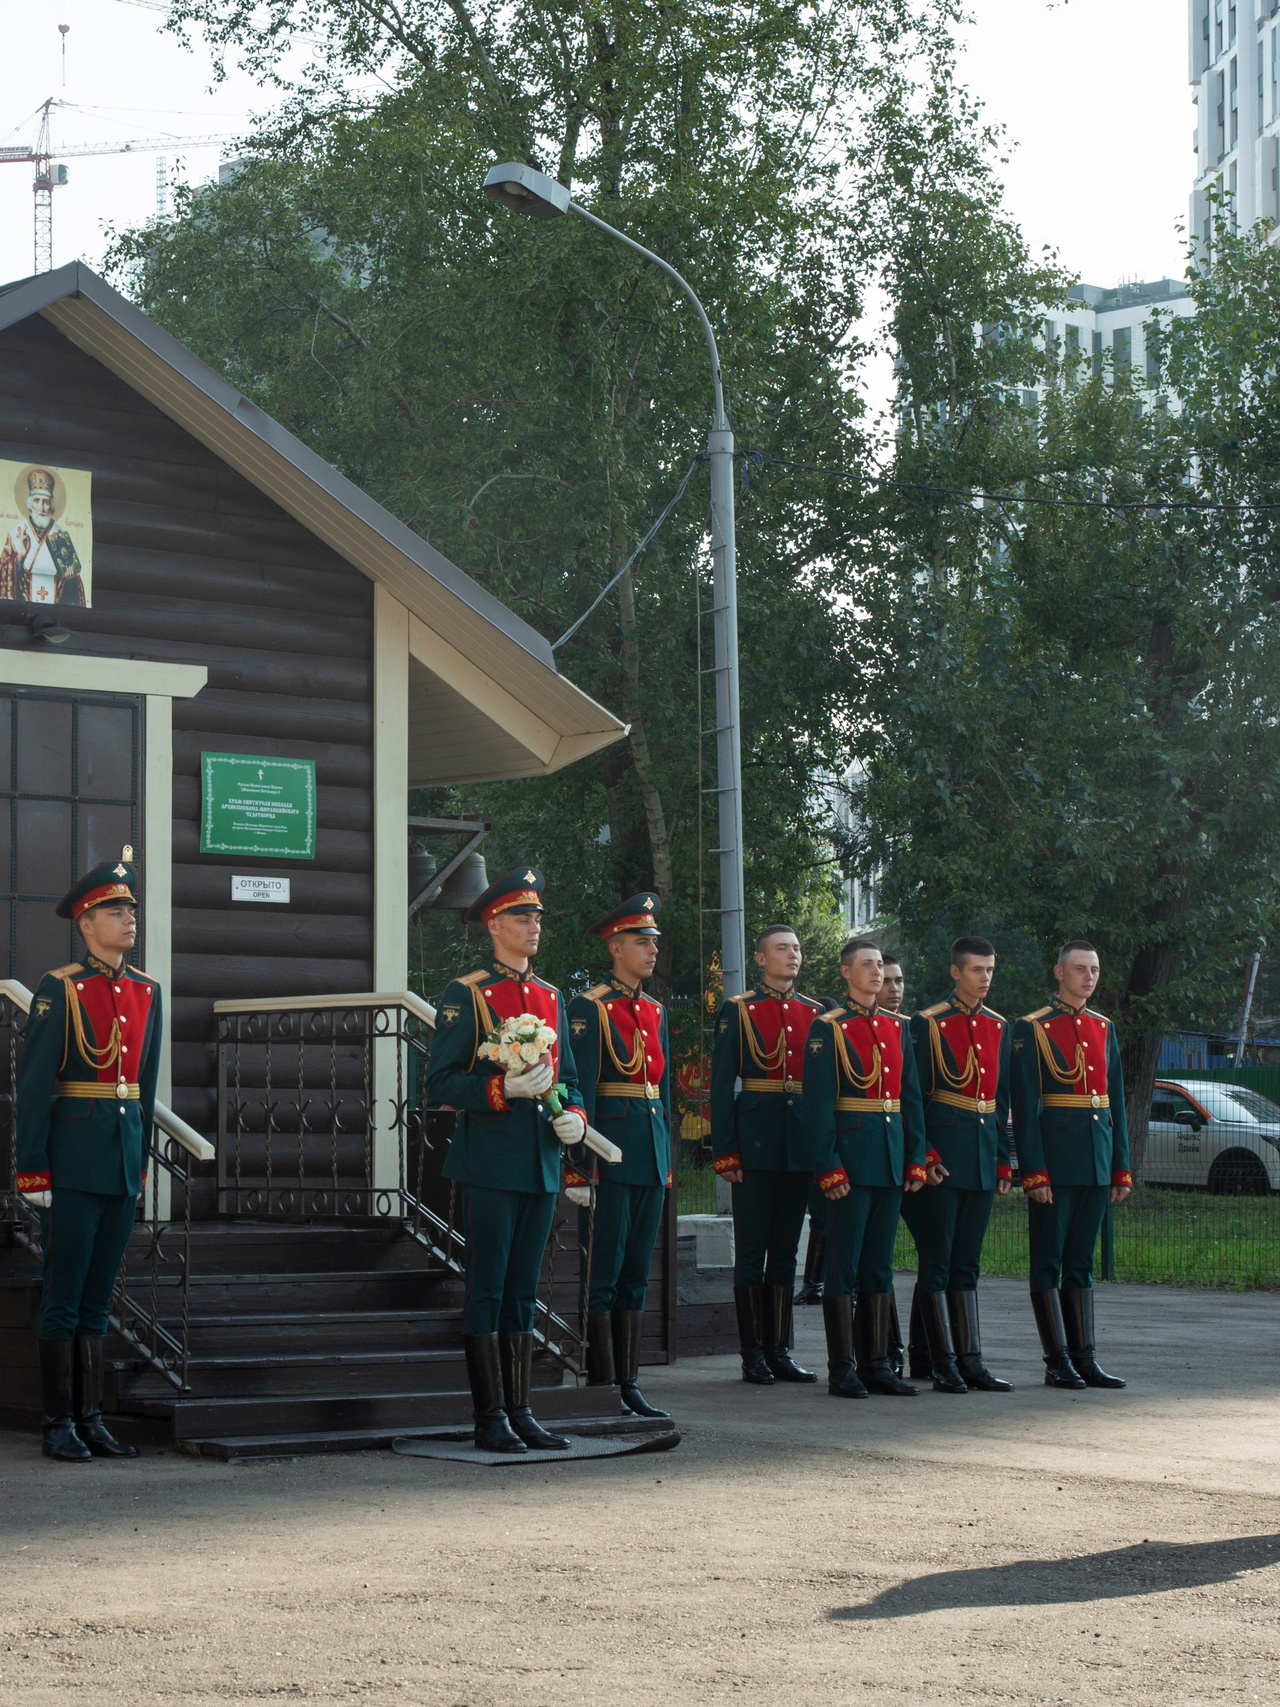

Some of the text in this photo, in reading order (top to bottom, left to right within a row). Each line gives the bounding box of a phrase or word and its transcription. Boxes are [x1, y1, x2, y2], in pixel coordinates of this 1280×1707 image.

[240, 880, 282, 889] ОТКРЫТО
[1177, 1132, 1201, 1141] Яндекс
[1178, 1143, 1200, 1153] Драйв
